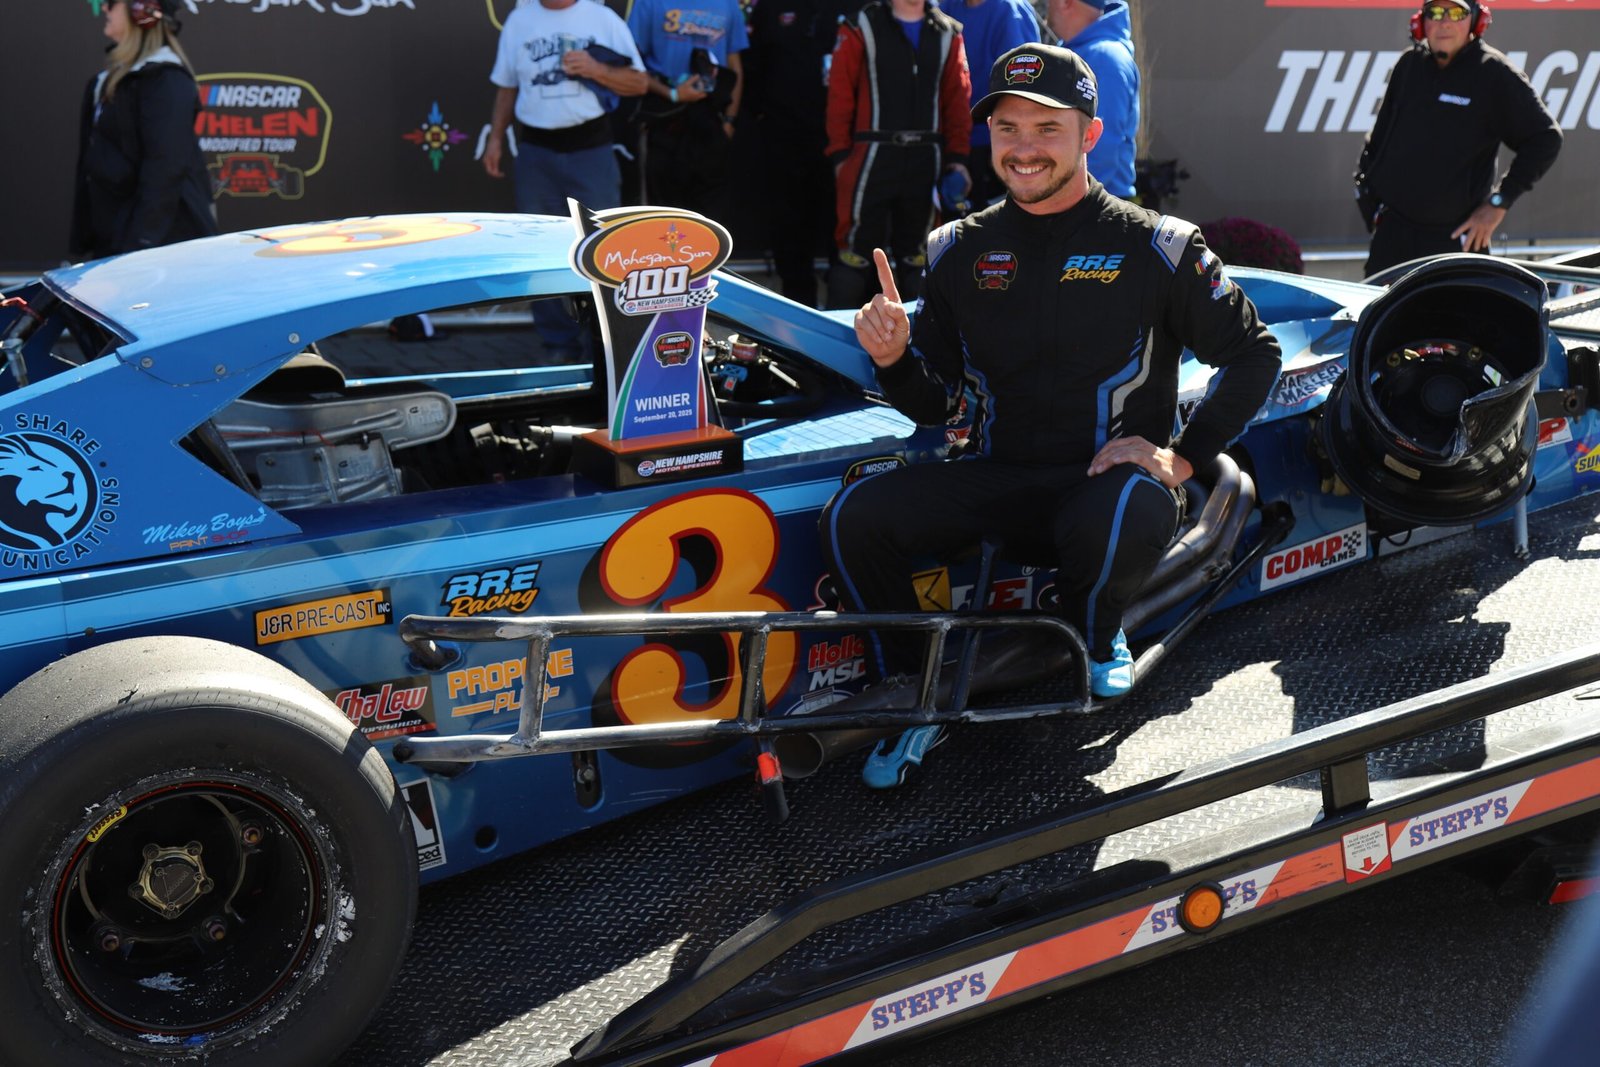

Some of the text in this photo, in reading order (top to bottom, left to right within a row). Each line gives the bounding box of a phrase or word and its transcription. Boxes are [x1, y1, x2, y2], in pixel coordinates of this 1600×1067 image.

[217, 85, 302, 107] NASCAR
[199, 138, 297, 152] MODIFIED TOUR
[604, 245, 712, 271] Mohegan Sun
[1063, 254, 1126, 270] BRE
[626, 265, 690, 300] 100
[1060, 267, 1121, 284] Racing
[651, 296, 685, 305] HAMPSHIRE
[633, 413, 667, 423] September
[678, 409, 693, 417] 2025
[635, 393, 690, 412] WINNER
[16, 413, 100, 455] SHARE
[656, 451, 723, 468] NEW HAMPSHIRE
[682, 460, 721, 470] SPEEDWAY
[866, 460, 898, 474] NASCAR
[1, 477, 120, 569] UNICATIONS
[142, 509, 264, 545] Mikey Boys
[1266, 535, 1343, 580] COMP
[1320, 548, 1357, 567] CAMS
[446, 563, 540, 602] BRE
[449, 588, 539, 617] Racing
[260, 599, 391, 637] J&R PRE-CAST INC
[601, 487, 800, 746] 3
[447, 648, 574, 699] PROPNE
[384, 724, 427, 737] PARTS
[1409, 796, 1509, 847] STEPP'S
[1151, 879, 1258, 934] STP'S
[871, 971, 986, 1031] STEPP'S
